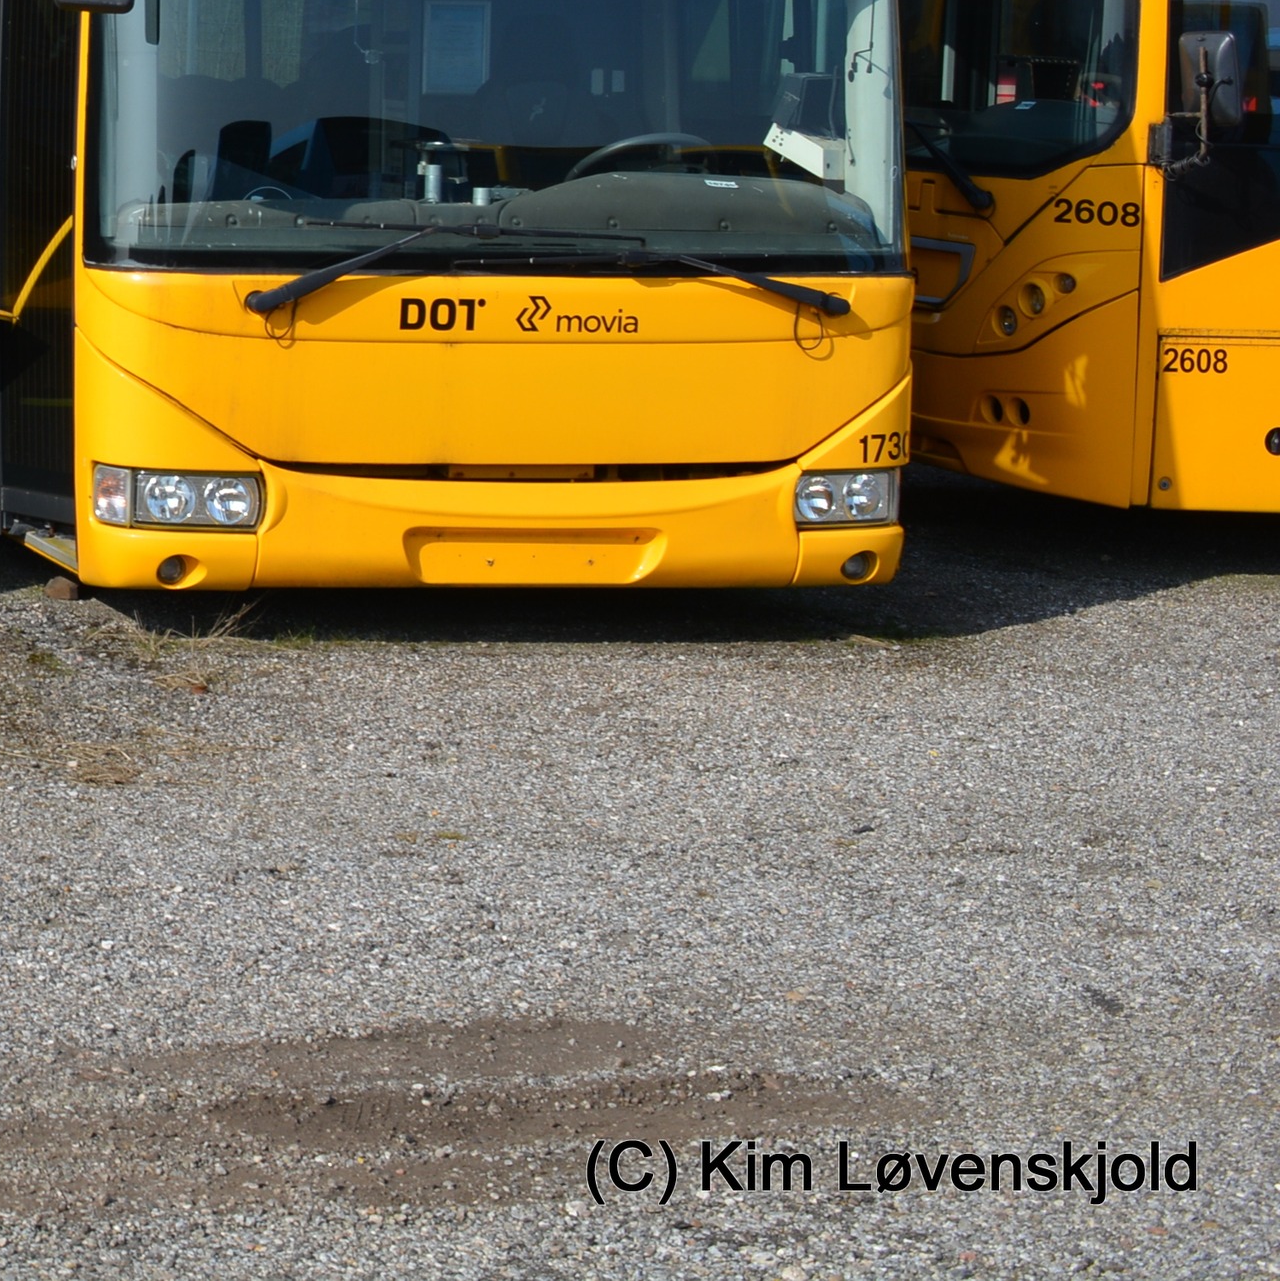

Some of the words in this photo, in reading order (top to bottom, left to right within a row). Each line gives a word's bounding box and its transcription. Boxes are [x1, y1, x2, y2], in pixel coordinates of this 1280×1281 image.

[1054, 198, 1140, 228] 2608
[399, 298, 486, 331] DOT
[556, 309, 639, 334] movia
[1163, 348, 1228, 374] 2608
